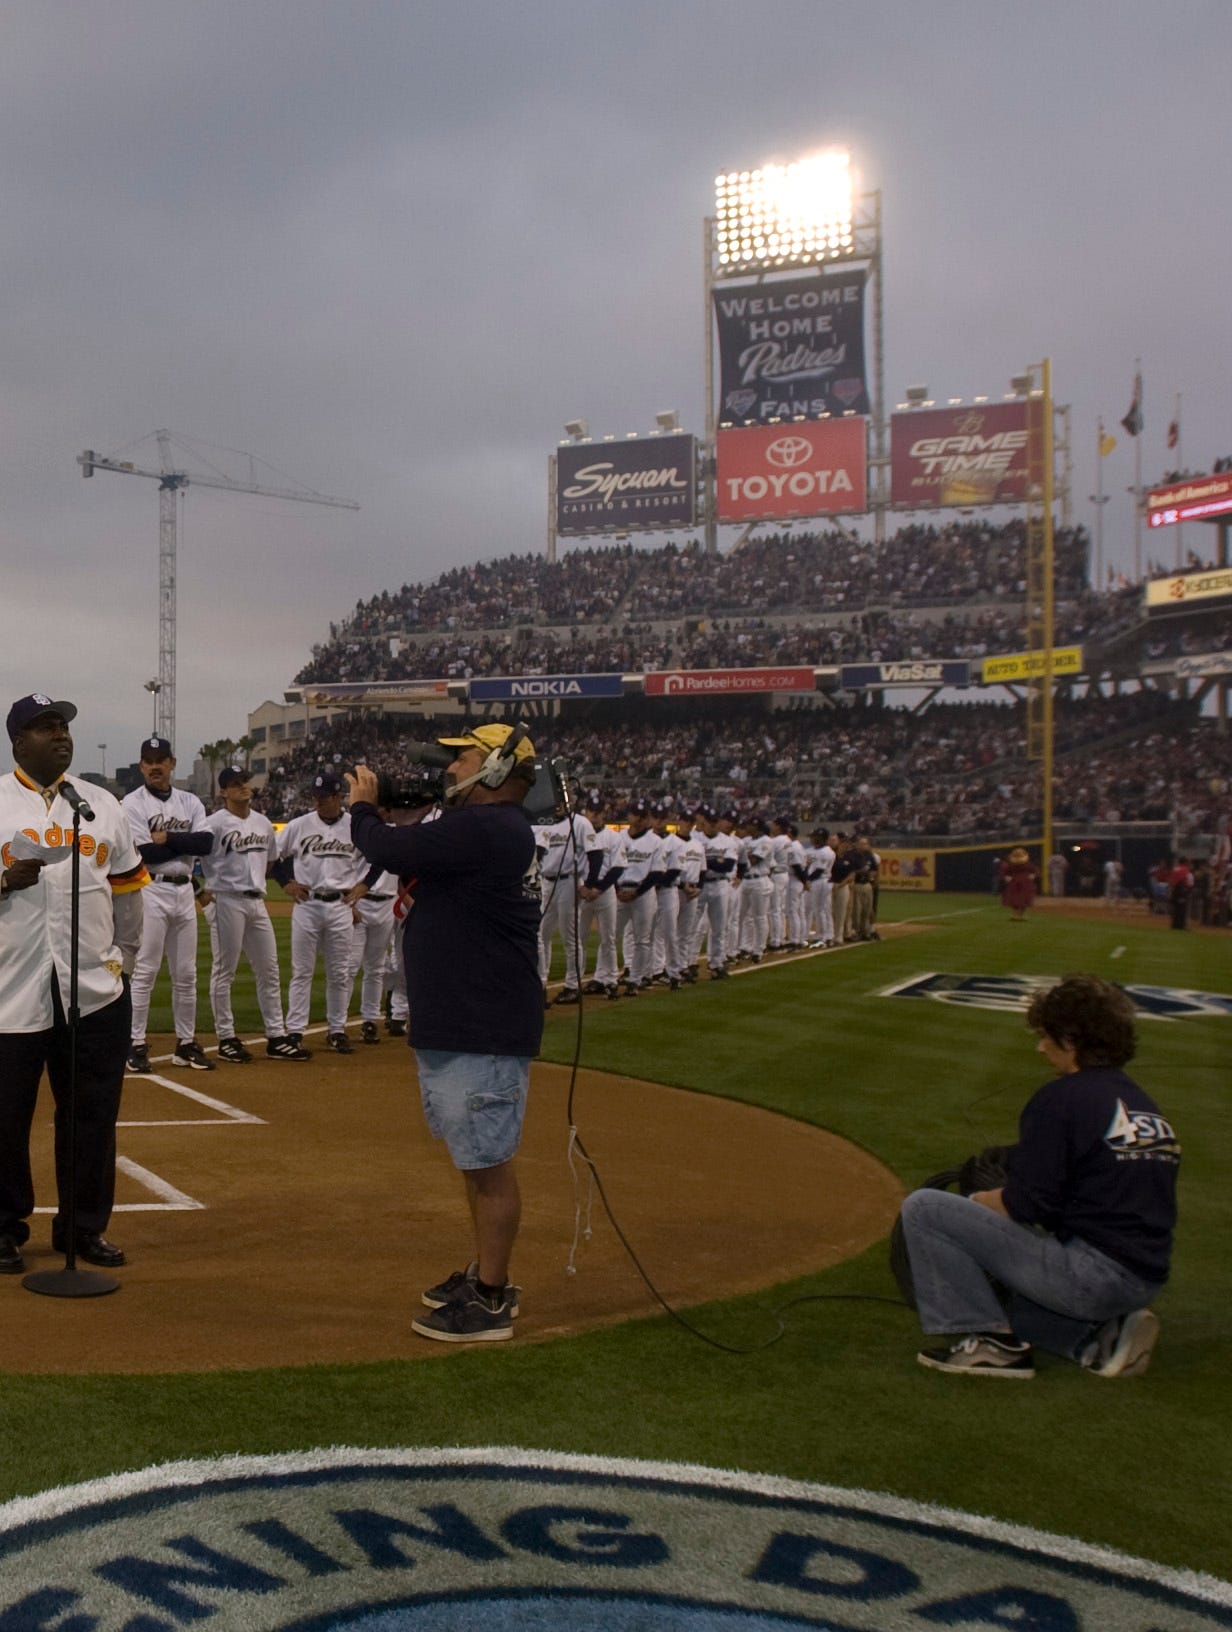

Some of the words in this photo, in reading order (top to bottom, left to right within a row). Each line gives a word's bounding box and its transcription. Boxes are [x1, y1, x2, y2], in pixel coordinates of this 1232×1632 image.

[720, 285, 860, 318] WELCOME
[749, 315, 834, 341] HOME
[738, 341, 847, 385] Padres
[759, 398, 826, 417] FANS
[909, 430, 1029, 457] GAME
[920, 450, 1016, 474] TIME
[562, 462, 688, 503] Sycuan
[727, 468, 853, 501] TOYOTA
[563, 502, 614, 513] CASINO
[635, 495, 687, 509] RESORT
[880, 662, 943, 682] ViaSat
[511, 680, 583, 697] NOKIA
